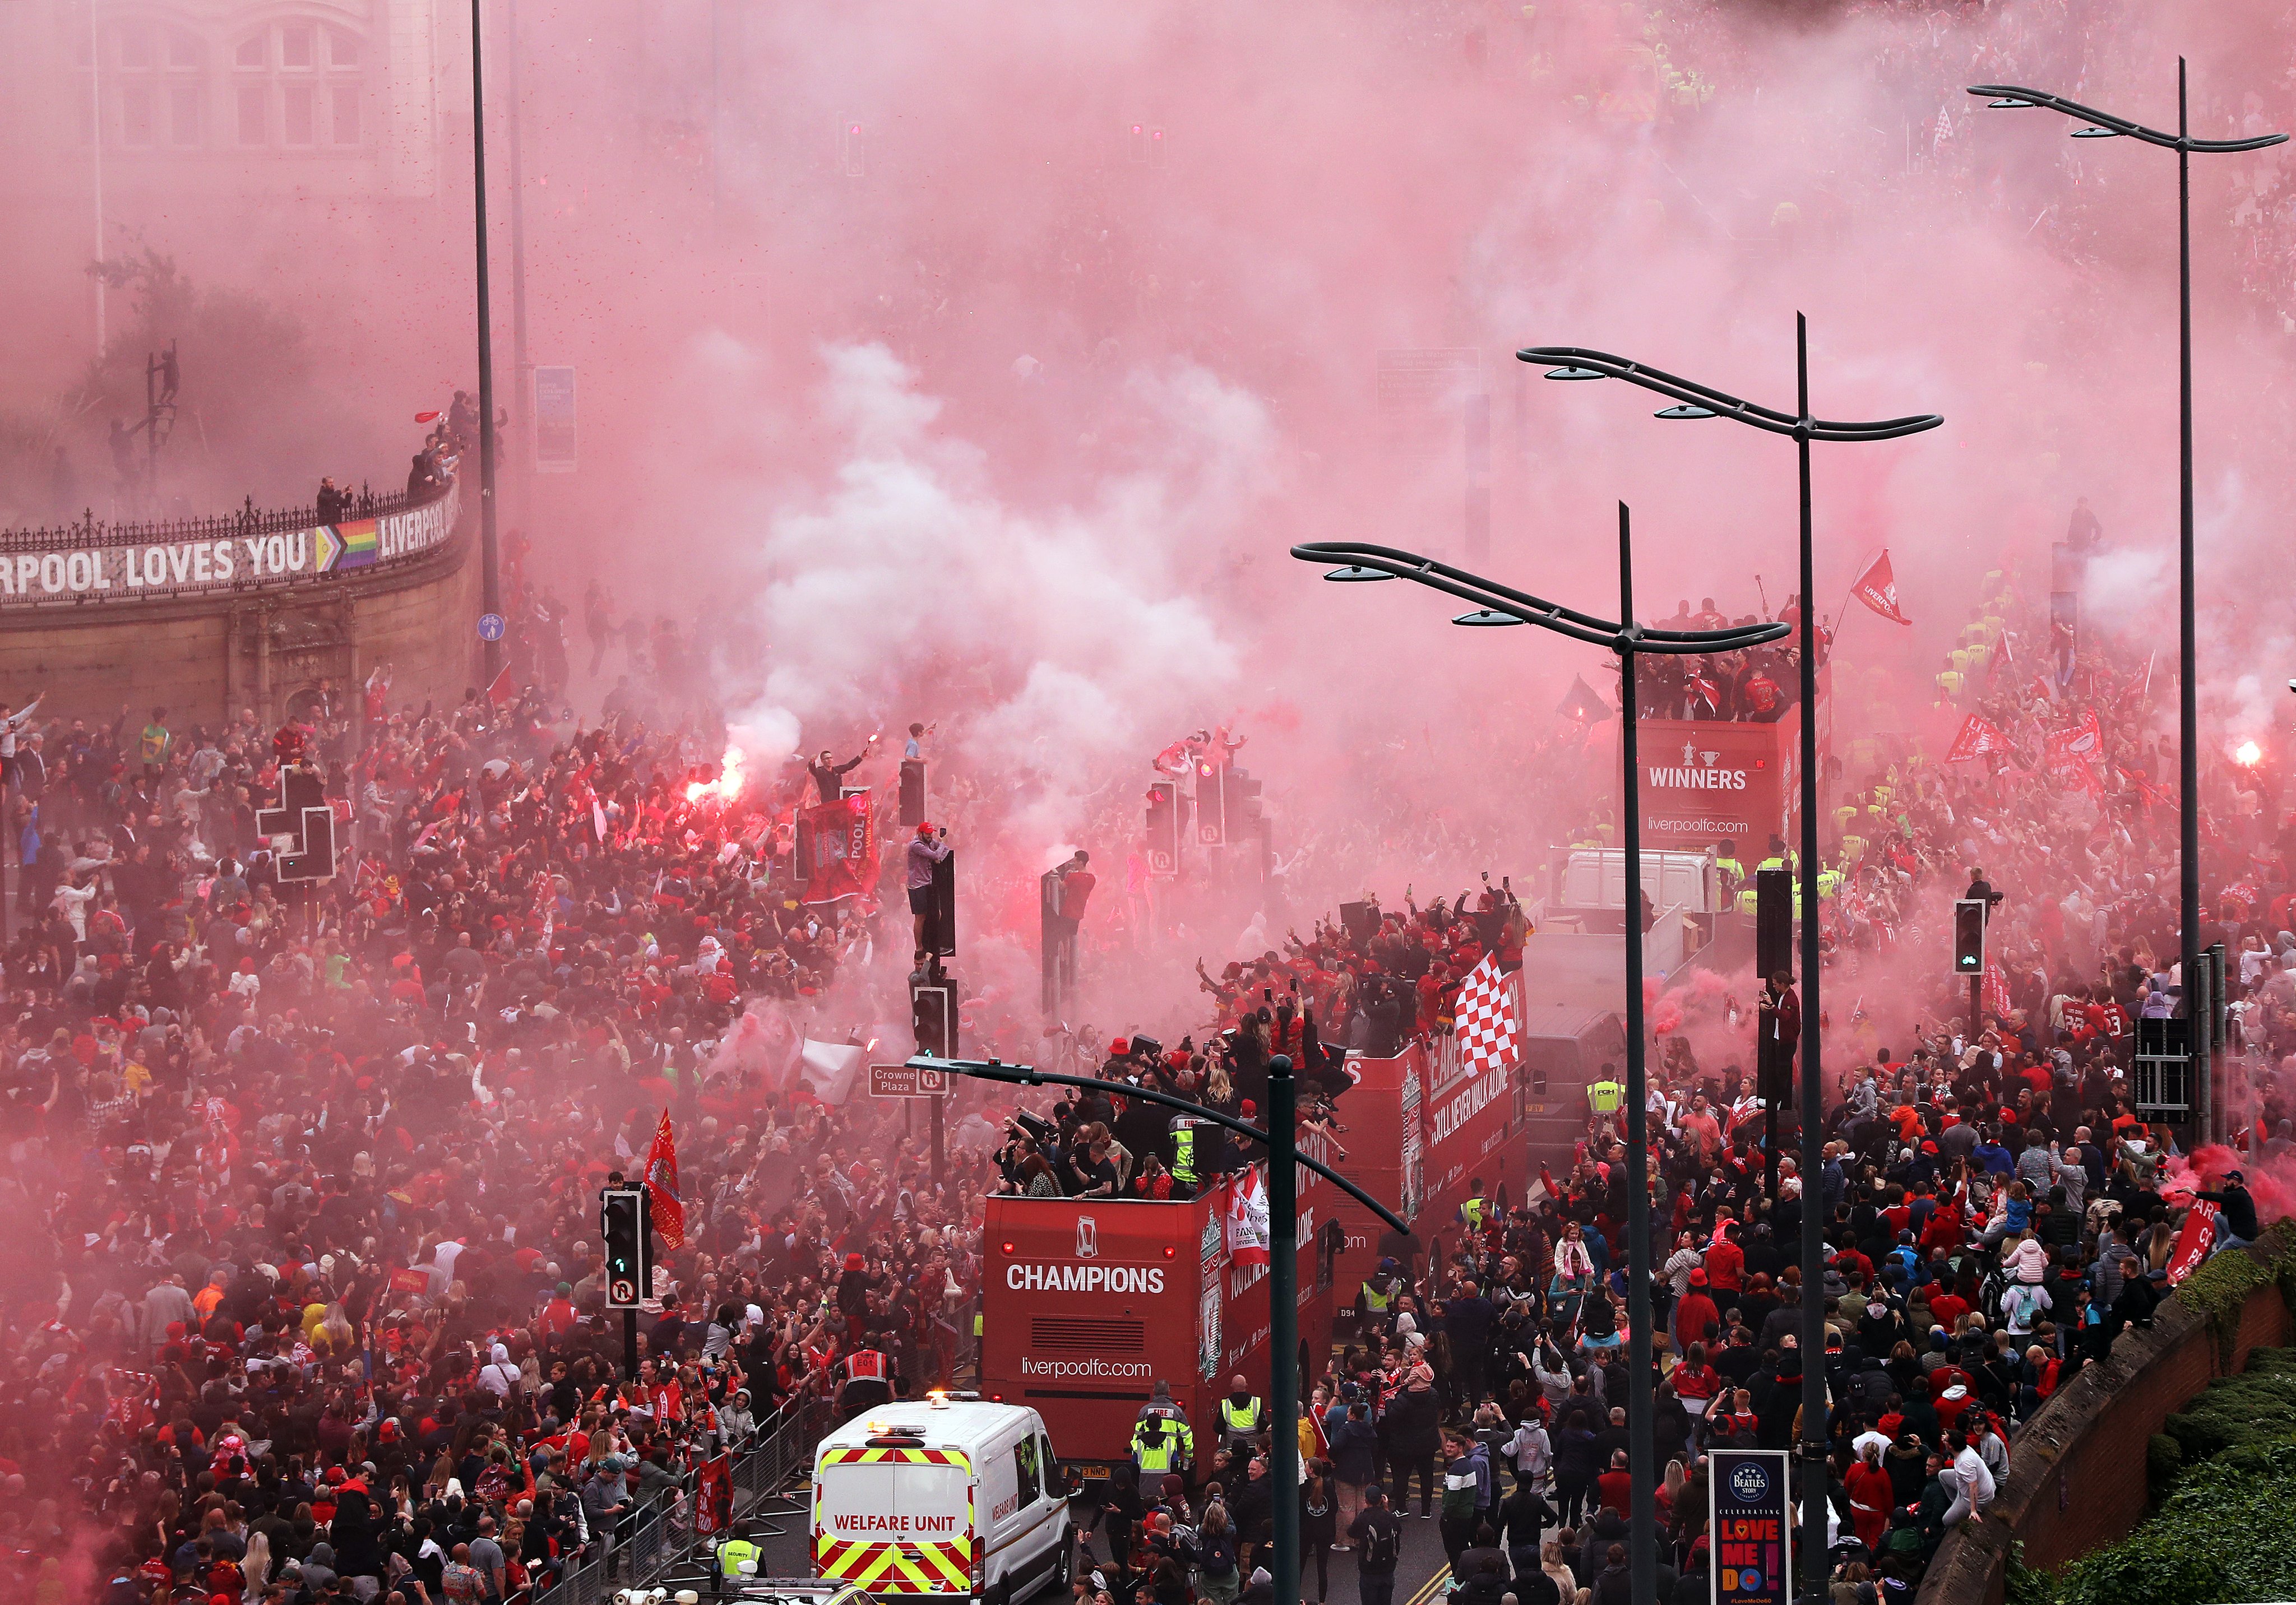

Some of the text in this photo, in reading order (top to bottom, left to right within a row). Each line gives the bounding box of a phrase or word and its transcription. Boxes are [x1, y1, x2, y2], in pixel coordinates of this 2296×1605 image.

[126, 541, 233, 587] LOVES
[245, 532, 307, 576] YOU
[1649, 767, 1746, 790] WINNERS
[1648, 816, 1748, 833] liverpoolfc.com
[875, 1070, 915, 1080] Crowne
[881, 1082, 909, 1091] Plaza
[1451, 1088, 1471, 1133] NEVER
[1471, 1073, 1488, 1115] WALK
[1488, 1063, 1508, 1103] ALONE
[1296, 1206, 1314, 1252] LONE
[1007, 1264, 1165, 1294] CHAMPIONS
[1022, 1356, 1151, 1379] liverpoolfc.com
[1734, 1474, 1765, 1487] BEATLES
[992, 1492, 1018, 1522] WELFARE UNIT
[834, 1514, 956, 1532] WELFARE UNIT
[1721, 1519, 1779, 1541] LOVE
[1722, 1543, 1758, 1566] ME
